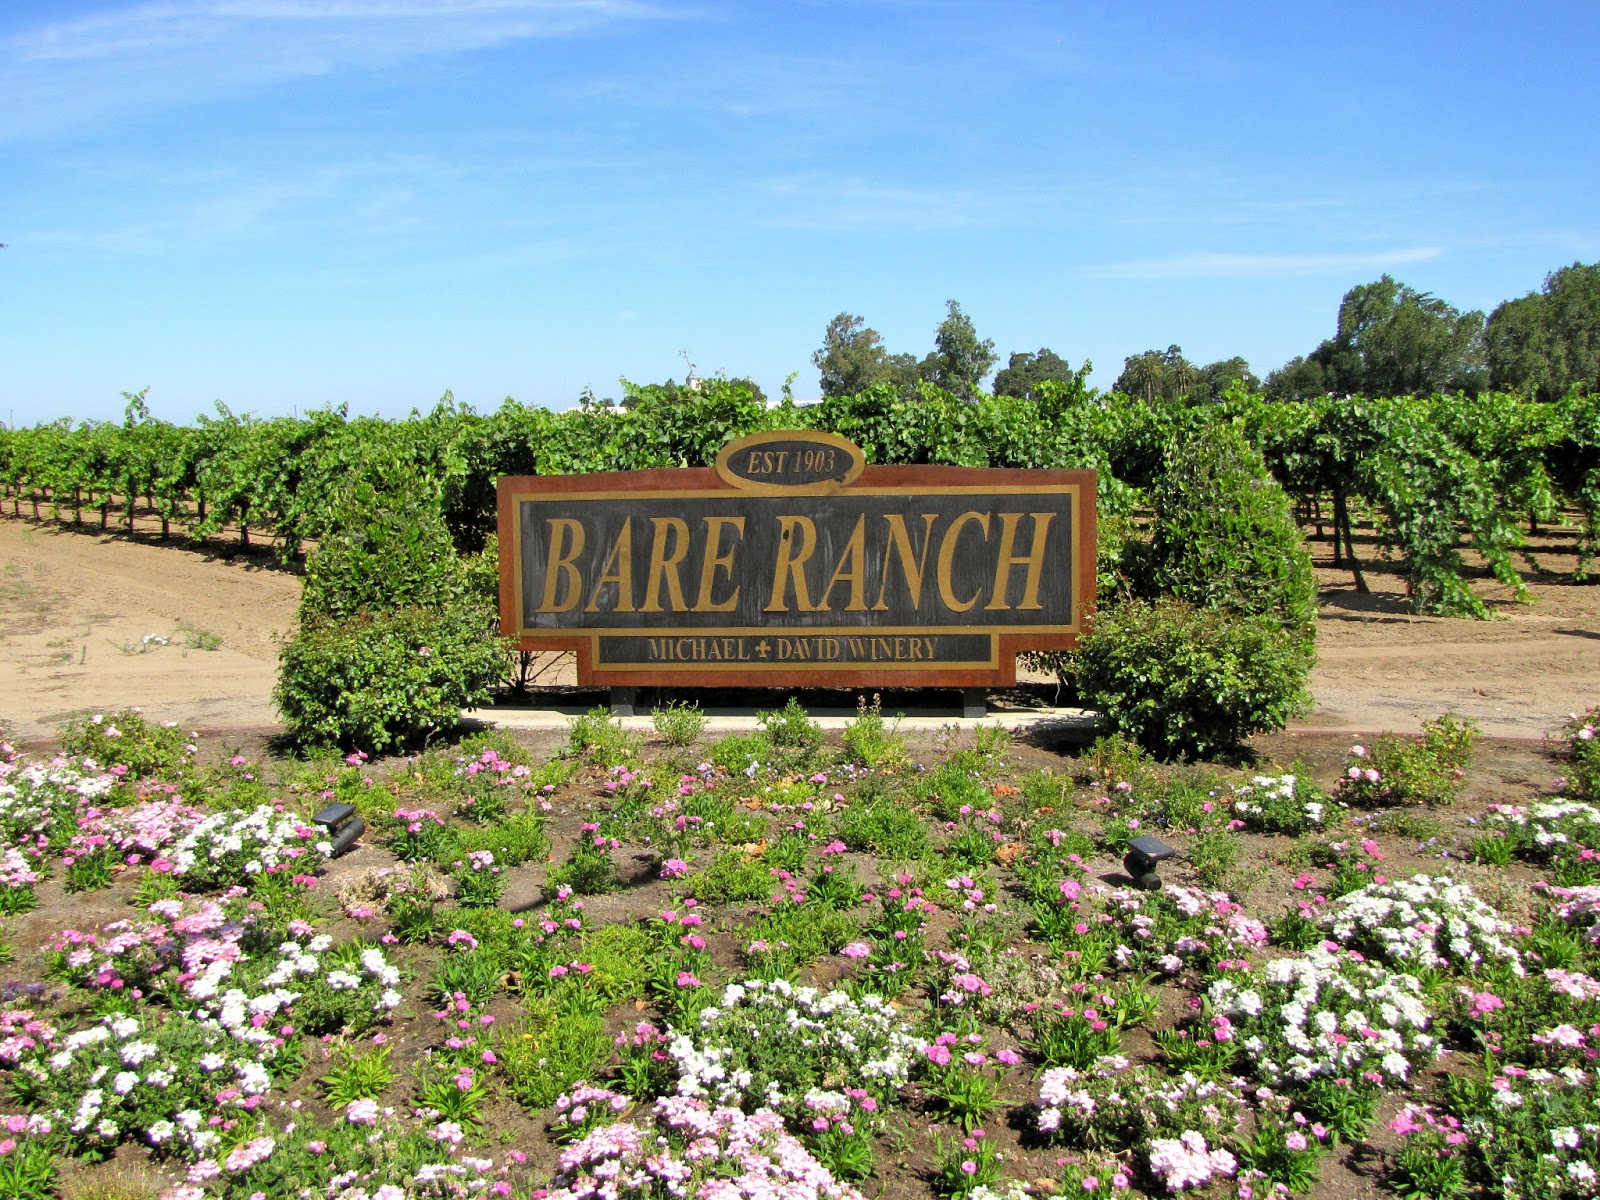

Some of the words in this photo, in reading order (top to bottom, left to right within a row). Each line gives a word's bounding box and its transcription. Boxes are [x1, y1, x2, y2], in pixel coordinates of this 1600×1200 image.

[747, 450, 788, 474] EST
[794, 449, 835, 473] 1903
[535, 515, 746, 613] BARE
[763, 510, 1057, 613] RANCH
[648, 638, 750, 660] MICHAEL
[776, 637, 841, 660] DAVID
[849, 636, 939, 660] WINERY
